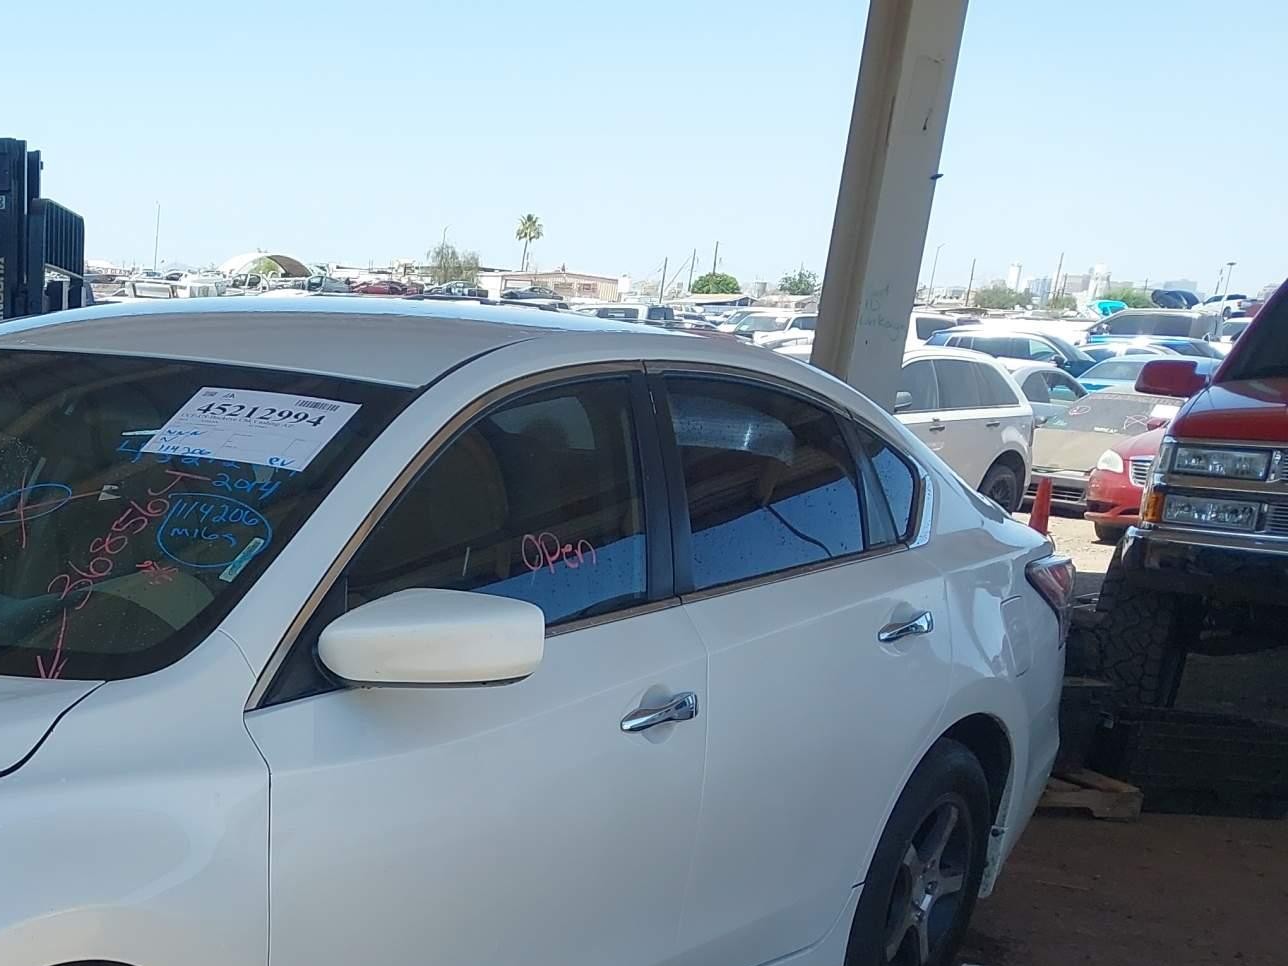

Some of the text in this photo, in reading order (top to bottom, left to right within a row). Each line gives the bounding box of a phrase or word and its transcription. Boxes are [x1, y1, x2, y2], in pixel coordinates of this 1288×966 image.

[197, 402, 326, 428] 45212994
[212, 473, 281, 500] 2014
[175, 499, 259, 526] 114206
